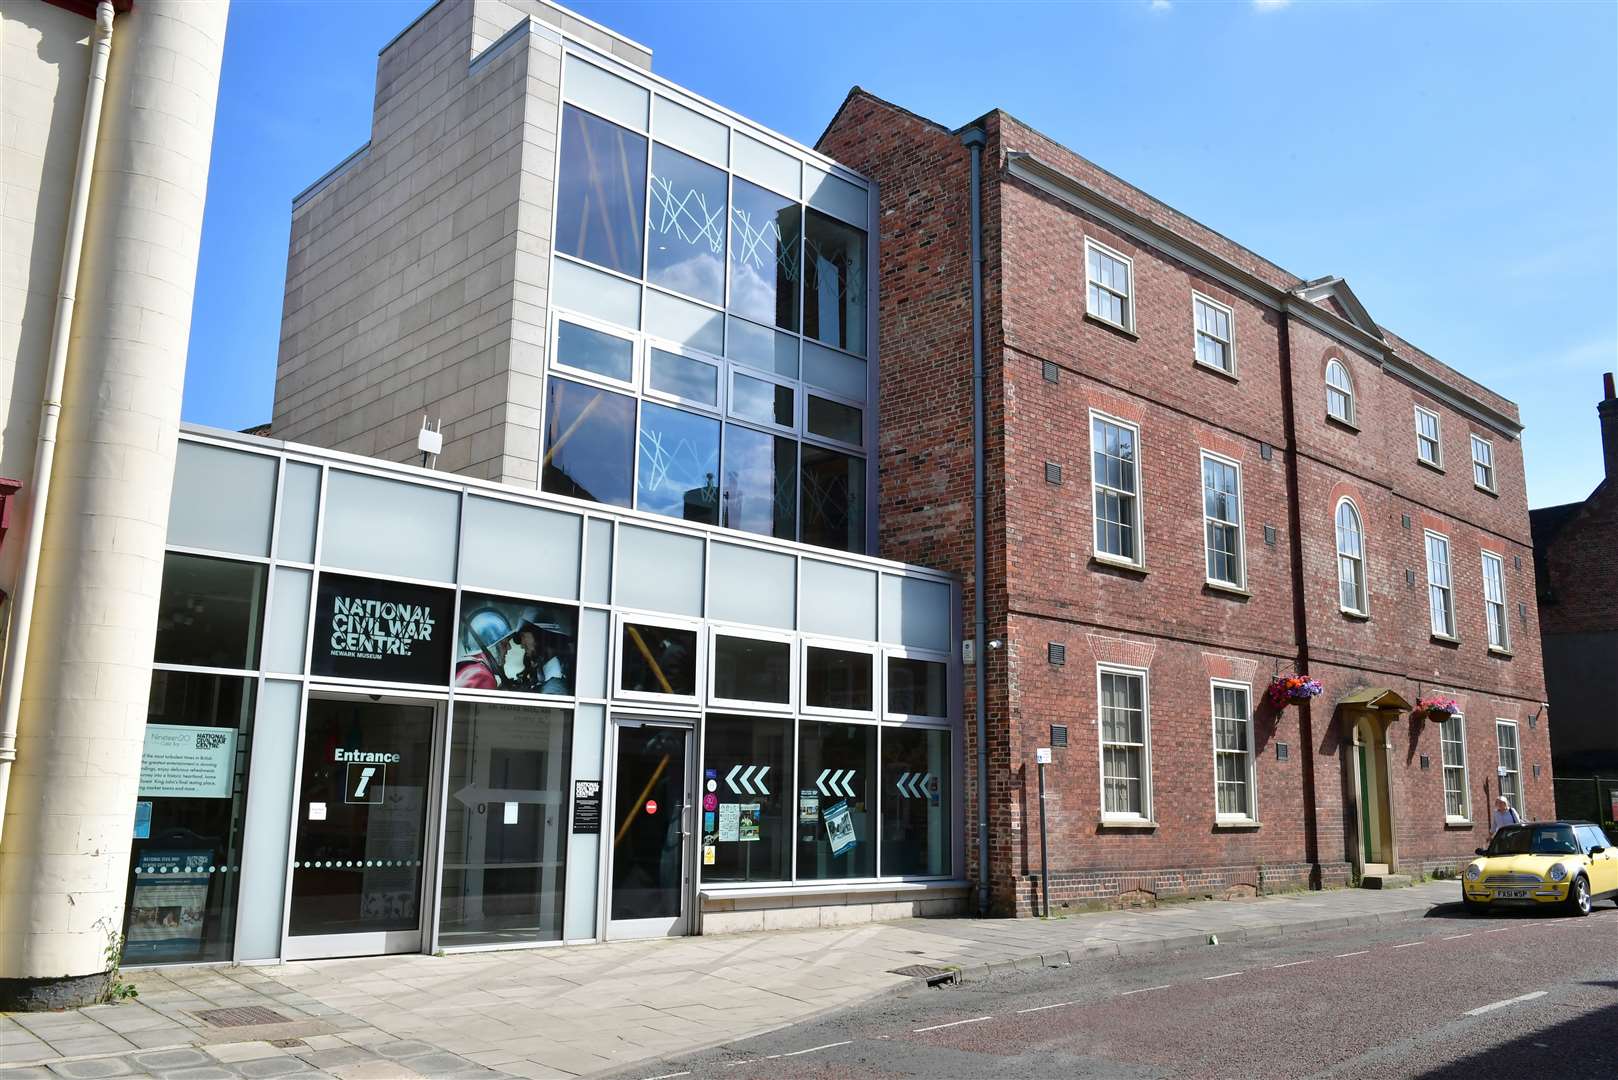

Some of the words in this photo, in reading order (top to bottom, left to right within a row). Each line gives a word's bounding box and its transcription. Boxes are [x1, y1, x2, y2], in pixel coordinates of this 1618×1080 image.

[334, 596, 435, 624] NATIONAL
[332, 614, 386, 636] CIVIL
[388, 619, 432, 640] WAR
[330, 632, 412, 656] CENTRE
[330, 650, 356, 658] NEWARK
[356, 652, 383, 660] MUSEUM
[334, 748, 400, 763] Entrance
